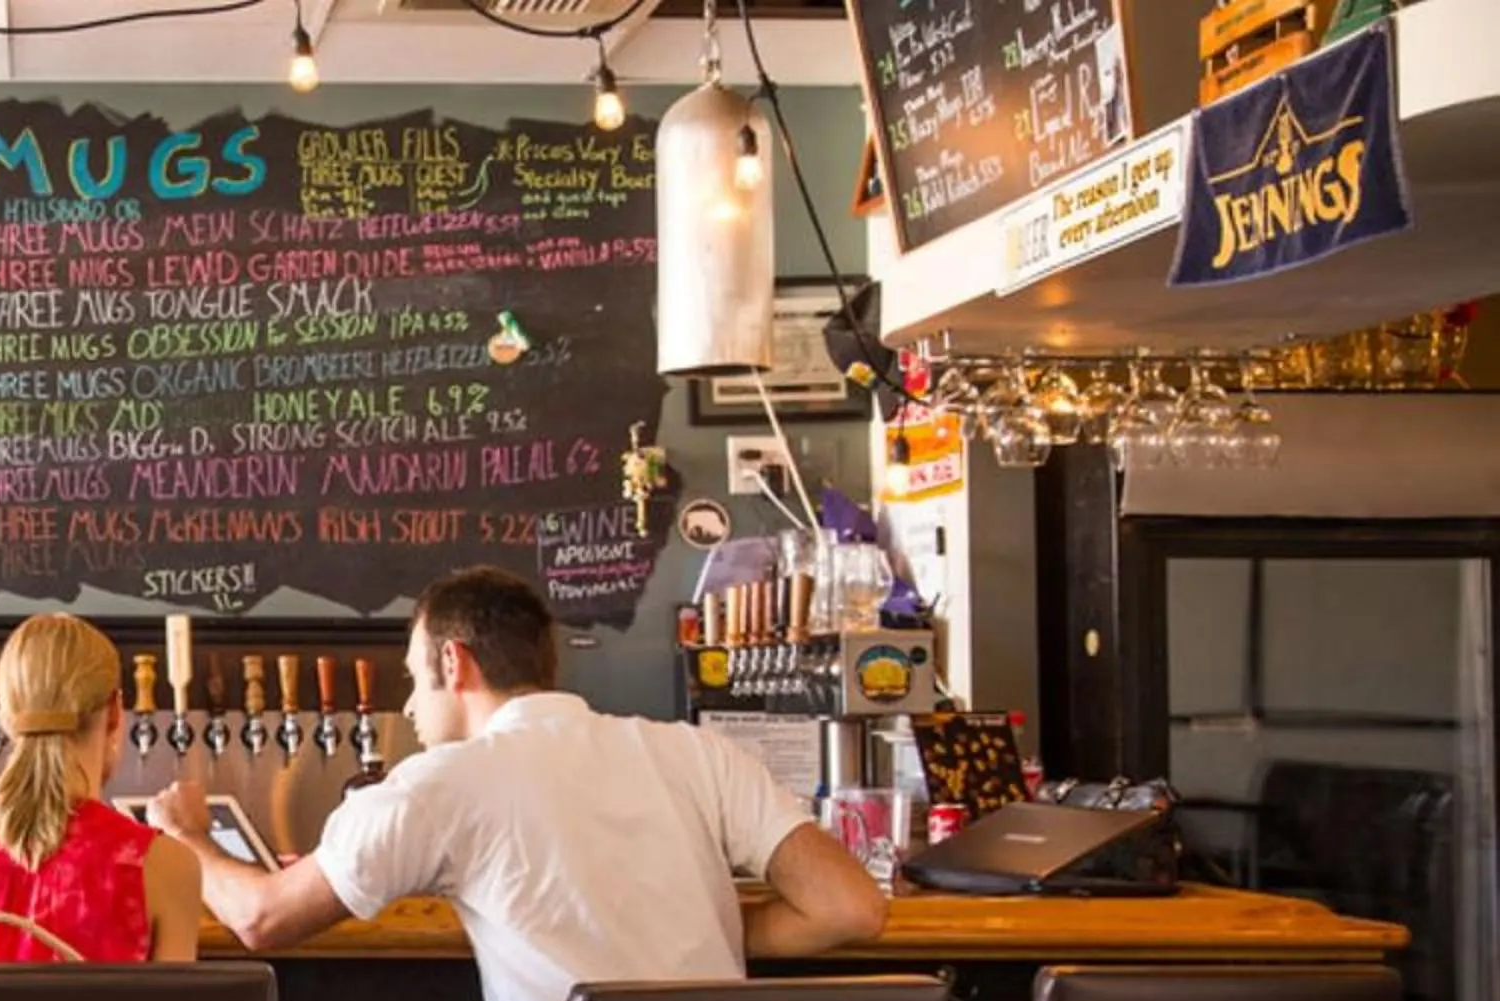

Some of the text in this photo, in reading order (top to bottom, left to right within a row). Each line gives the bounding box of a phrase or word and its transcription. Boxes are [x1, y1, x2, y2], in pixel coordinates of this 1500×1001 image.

[402, 127, 462, 164] FILLS
[1053, 191, 1075, 221] The
[1121, 160, 1129, 191] I
[1130, 155, 1152, 196] get
[1154, 148, 1174, 182] up
[1211, 139, 1365, 269] JENNINGS
[58, 217, 145, 254] MUGS
[249, 207, 344, 244] SCHATZ
[67, 257, 136, 288] MUGS
[147, 250, 240, 287] LEWD
[245, 248, 340, 283] GARDEN
[343, 246, 413, 279] DUDE
[72, 287, 136, 328] MUGS
[143, 282, 257, 322] TONGUE
[266, 280, 374, 319] SMACK
[50, 333, 117, 363] MUGS
[126, 318, 259, 362] OBSESSION
[294, 313, 378, 345] SESSION
[389, 312, 427, 339] IPA
[55, 366, 126, 400] MUGS
[130, 356, 248, 401] ORGANIC
[39, 401, 101, 438] MUGS
[252, 388, 342, 421] HONEY
[348, 386, 406, 418] ALE
[36, 432, 102, 463] MUGS
[231, 418, 327, 454] STRONG
[333, 415, 418, 449] SCOTCH
[422, 415, 479, 444] ALE
[40, 462, 113, 500] MUGS
[320, 448, 469, 497] MANDARIN
[479, 445, 523, 487] PALE
[68, 506, 143, 543] MUGS
[317, 505, 382, 545] IRISH
[387, 507, 467, 545] STOUT
[561, 504, 635, 544] WINE
